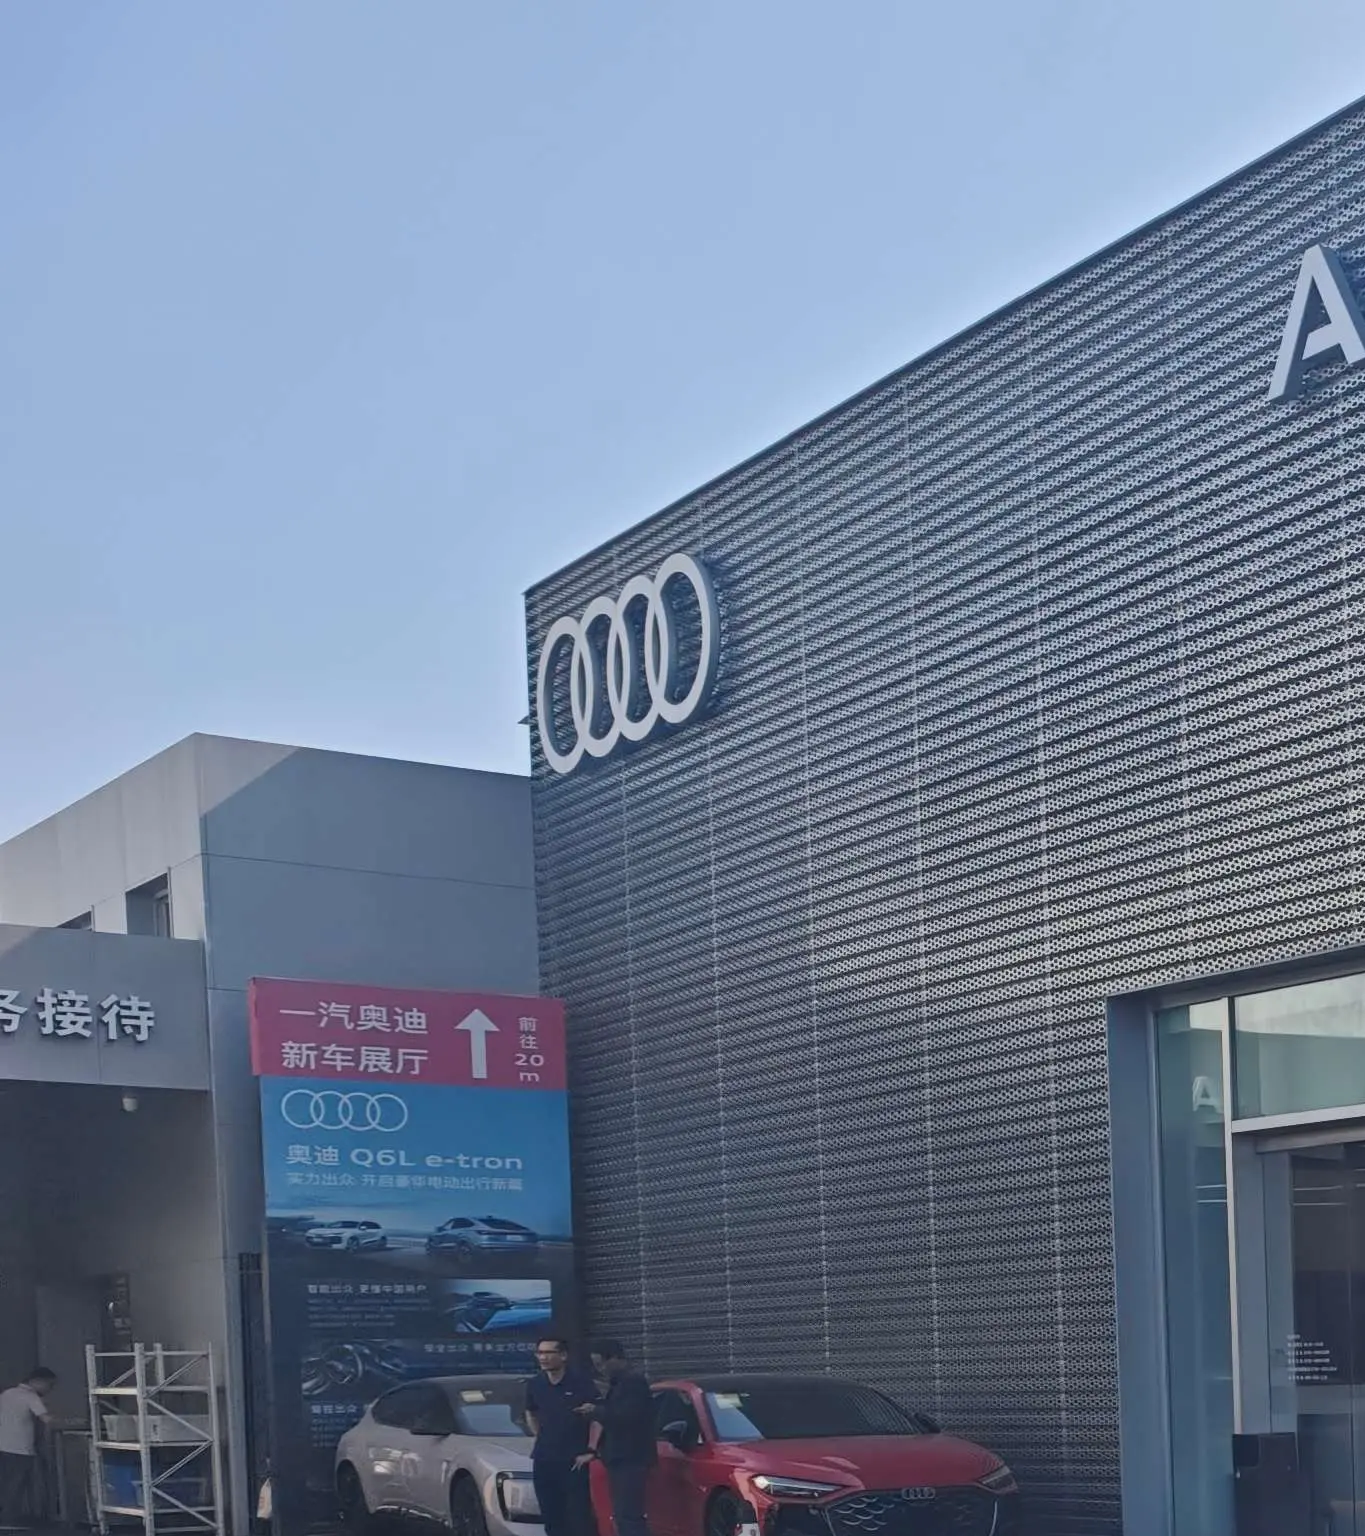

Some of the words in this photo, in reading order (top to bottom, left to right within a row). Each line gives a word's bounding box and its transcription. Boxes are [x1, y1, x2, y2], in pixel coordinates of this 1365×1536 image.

[279, 1001, 428, 1035] 一汽奥迪
[281, 1040, 429, 1075] 新车展厅
[286, 1144, 339, 1166] 奥迪
[350, 1148, 416, 1167] Q6L
[425, 1153, 523, 1170] e-tron
